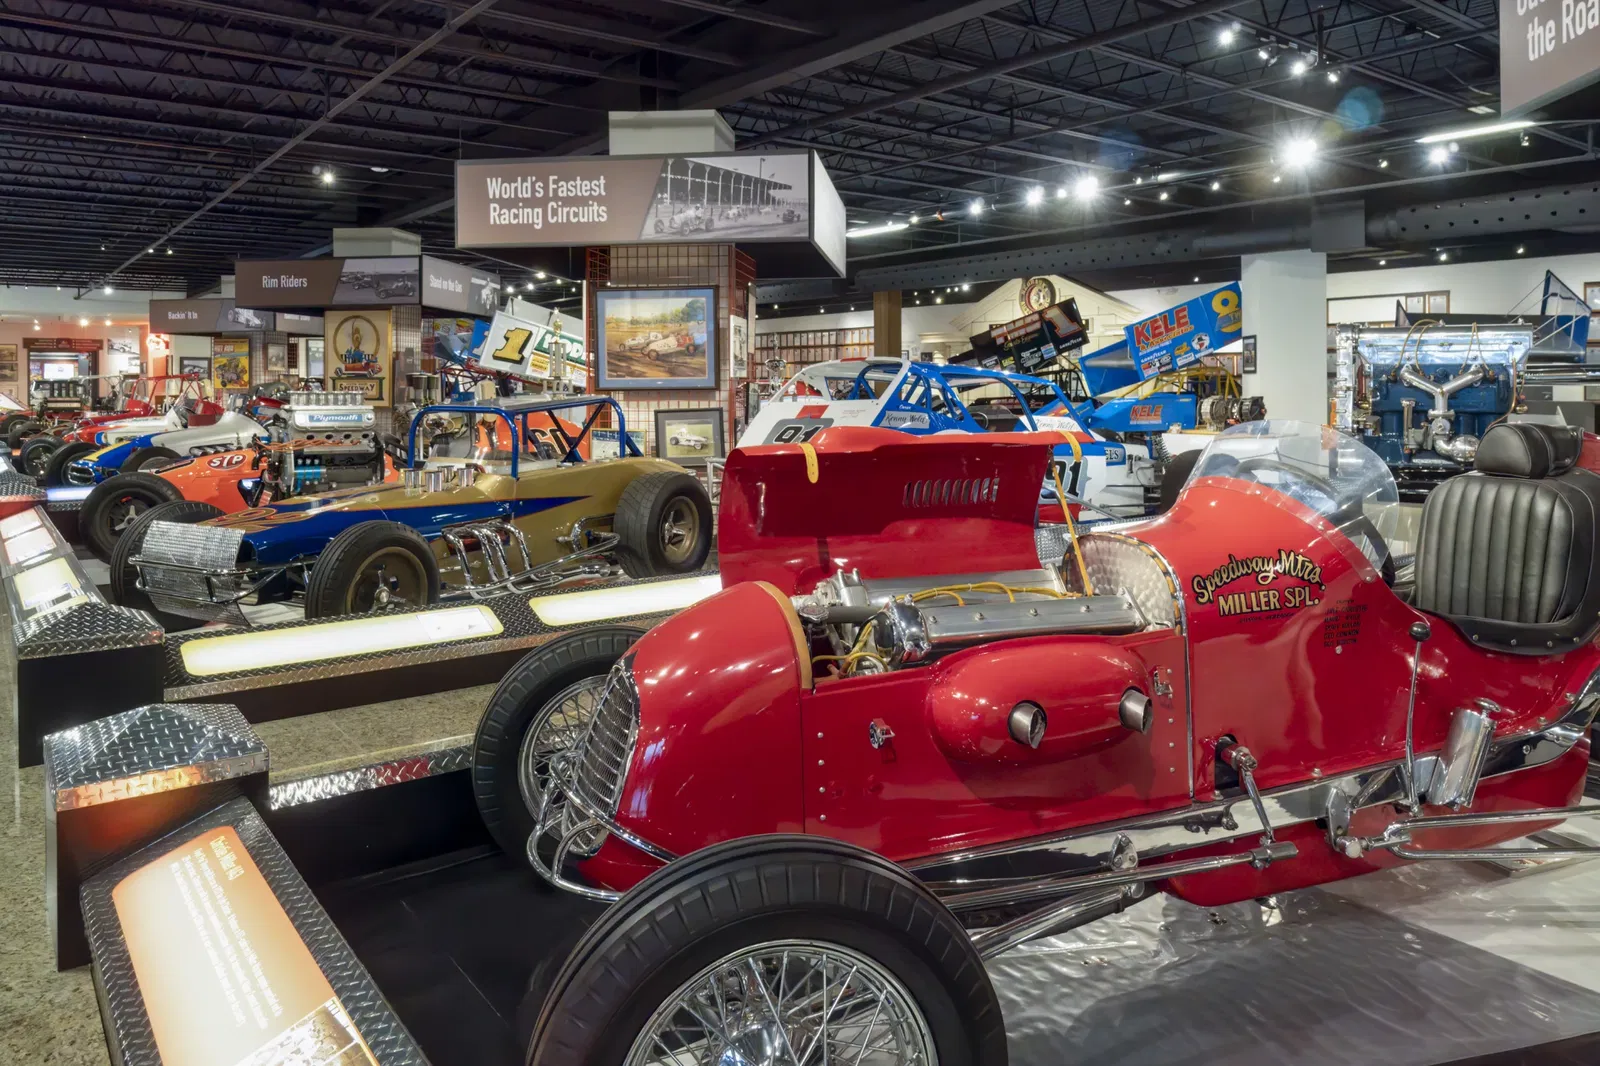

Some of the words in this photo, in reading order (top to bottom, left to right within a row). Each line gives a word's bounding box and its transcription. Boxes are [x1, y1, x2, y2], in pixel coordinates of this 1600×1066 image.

[1527, 17, 1556, 61] the
[487, 176, 544, 199] World's
[549, 175, 606, 198] Fastest
[490, 202, 543, 230] Racing
[548, 200, 608, 224] Circuits
[262, 275, 279, 288] Rim
[281, 274, 308, 288] Riders
[1041, 305, 1082, 339] 1
[1134, 306, 1190, 347] KELE
[493, 327, 533, 364] 1
[339, 383, 375, 391] SPEEDWAY
[1130, 404, 1164, 420] KELE
[210, 455, 246, 468] STP
[1193, 554, 1275, 605] Speedway
[1277, 549, 1327, 591] Mtrs
[1219, 590, 1281, 616] MILLER
[1283, 587, 1321, 609] SPL.
